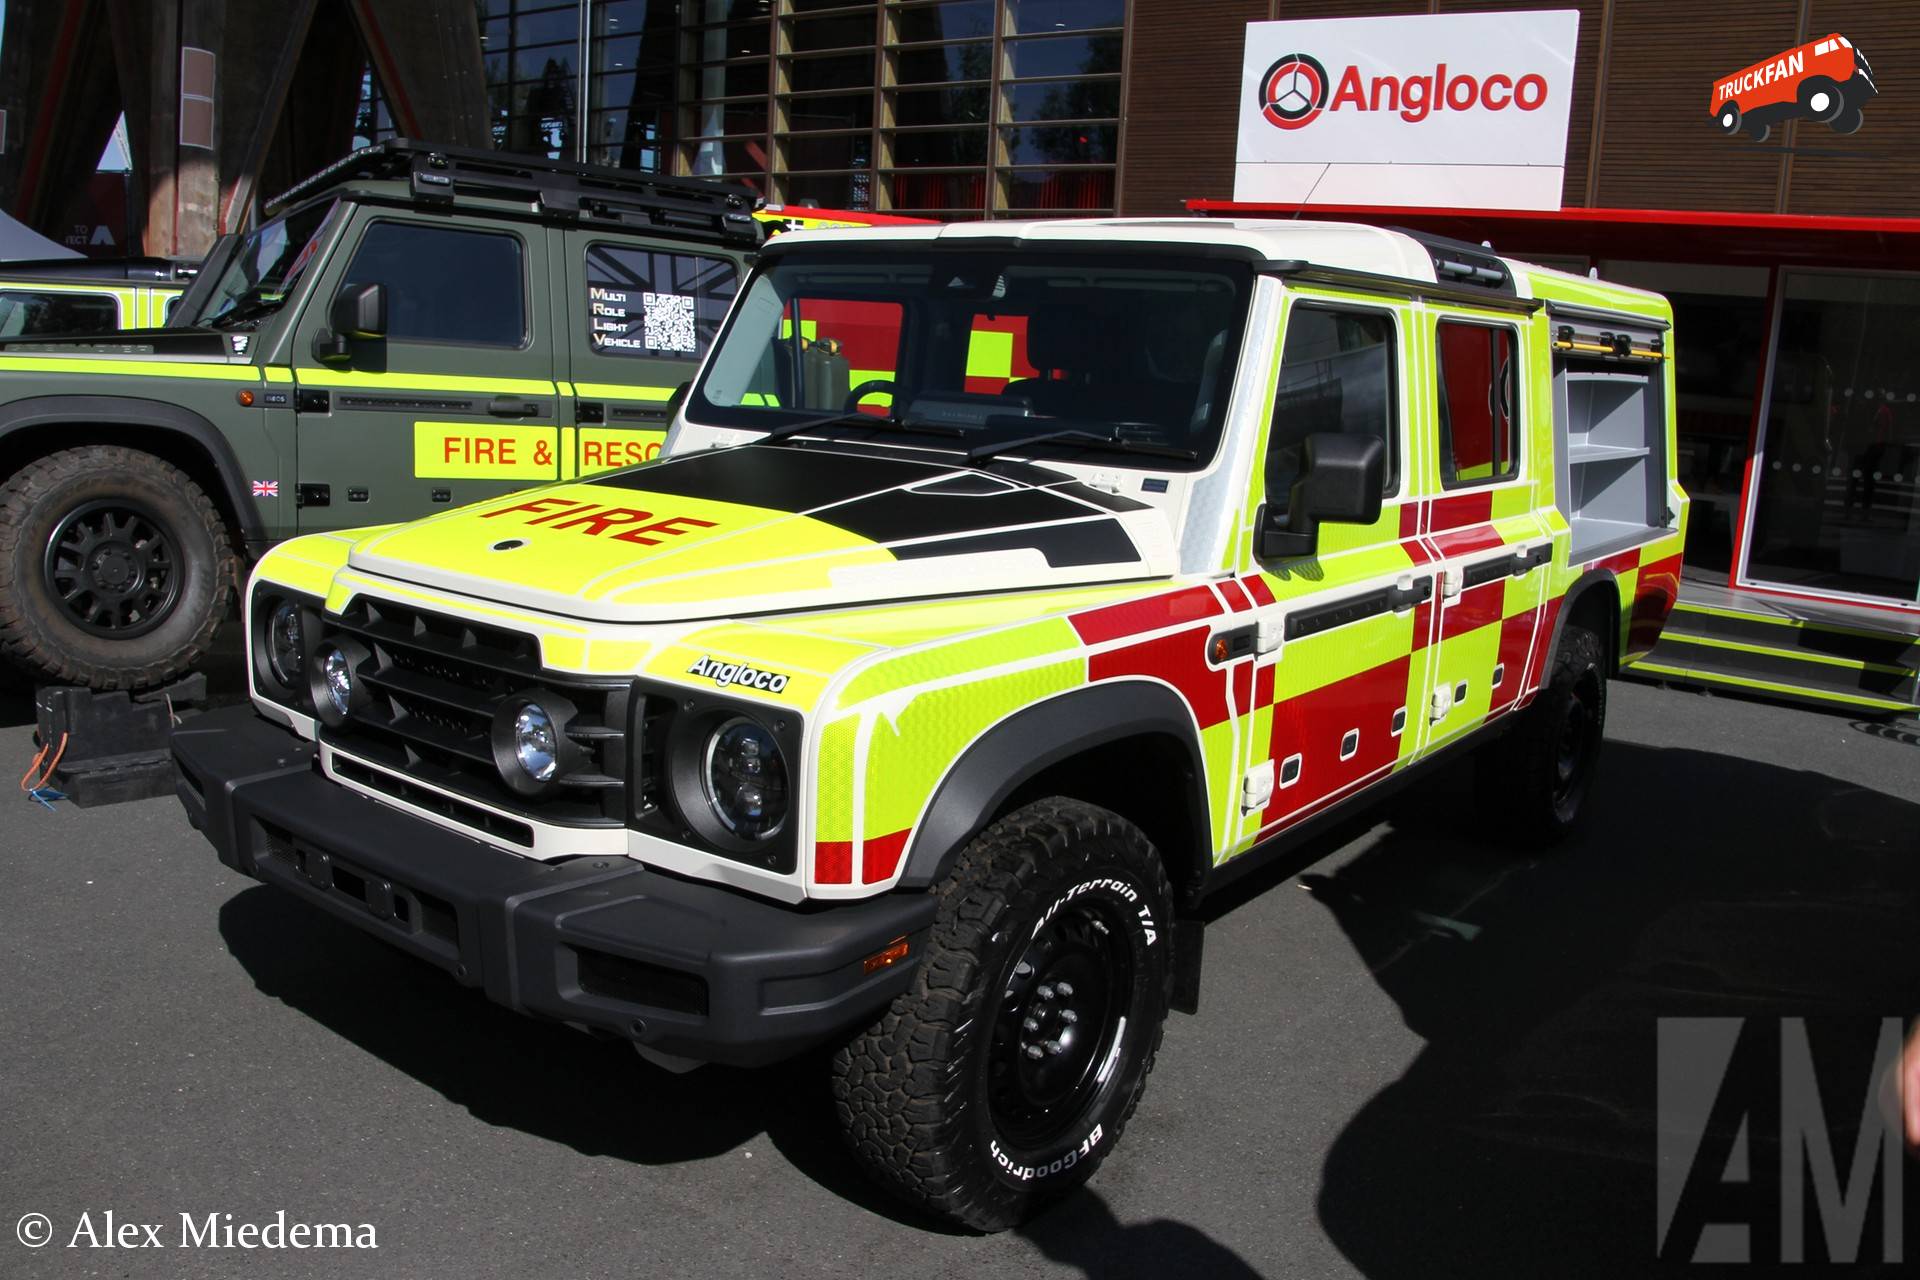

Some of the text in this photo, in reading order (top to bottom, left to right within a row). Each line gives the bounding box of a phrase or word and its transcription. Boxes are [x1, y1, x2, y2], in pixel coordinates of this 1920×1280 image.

[1329, 63, 1548, 123] Angloco
[443, 437, 517, 464] FIRE
[533, 440, 553, 465] &
[480, 498, 721, 546] FIRE
[687, 654, 790, 693] Angloco
[1031, 878, 1138, 940] All-Terrain
[990, 1123, 1104, 1181] BFGoodrich
